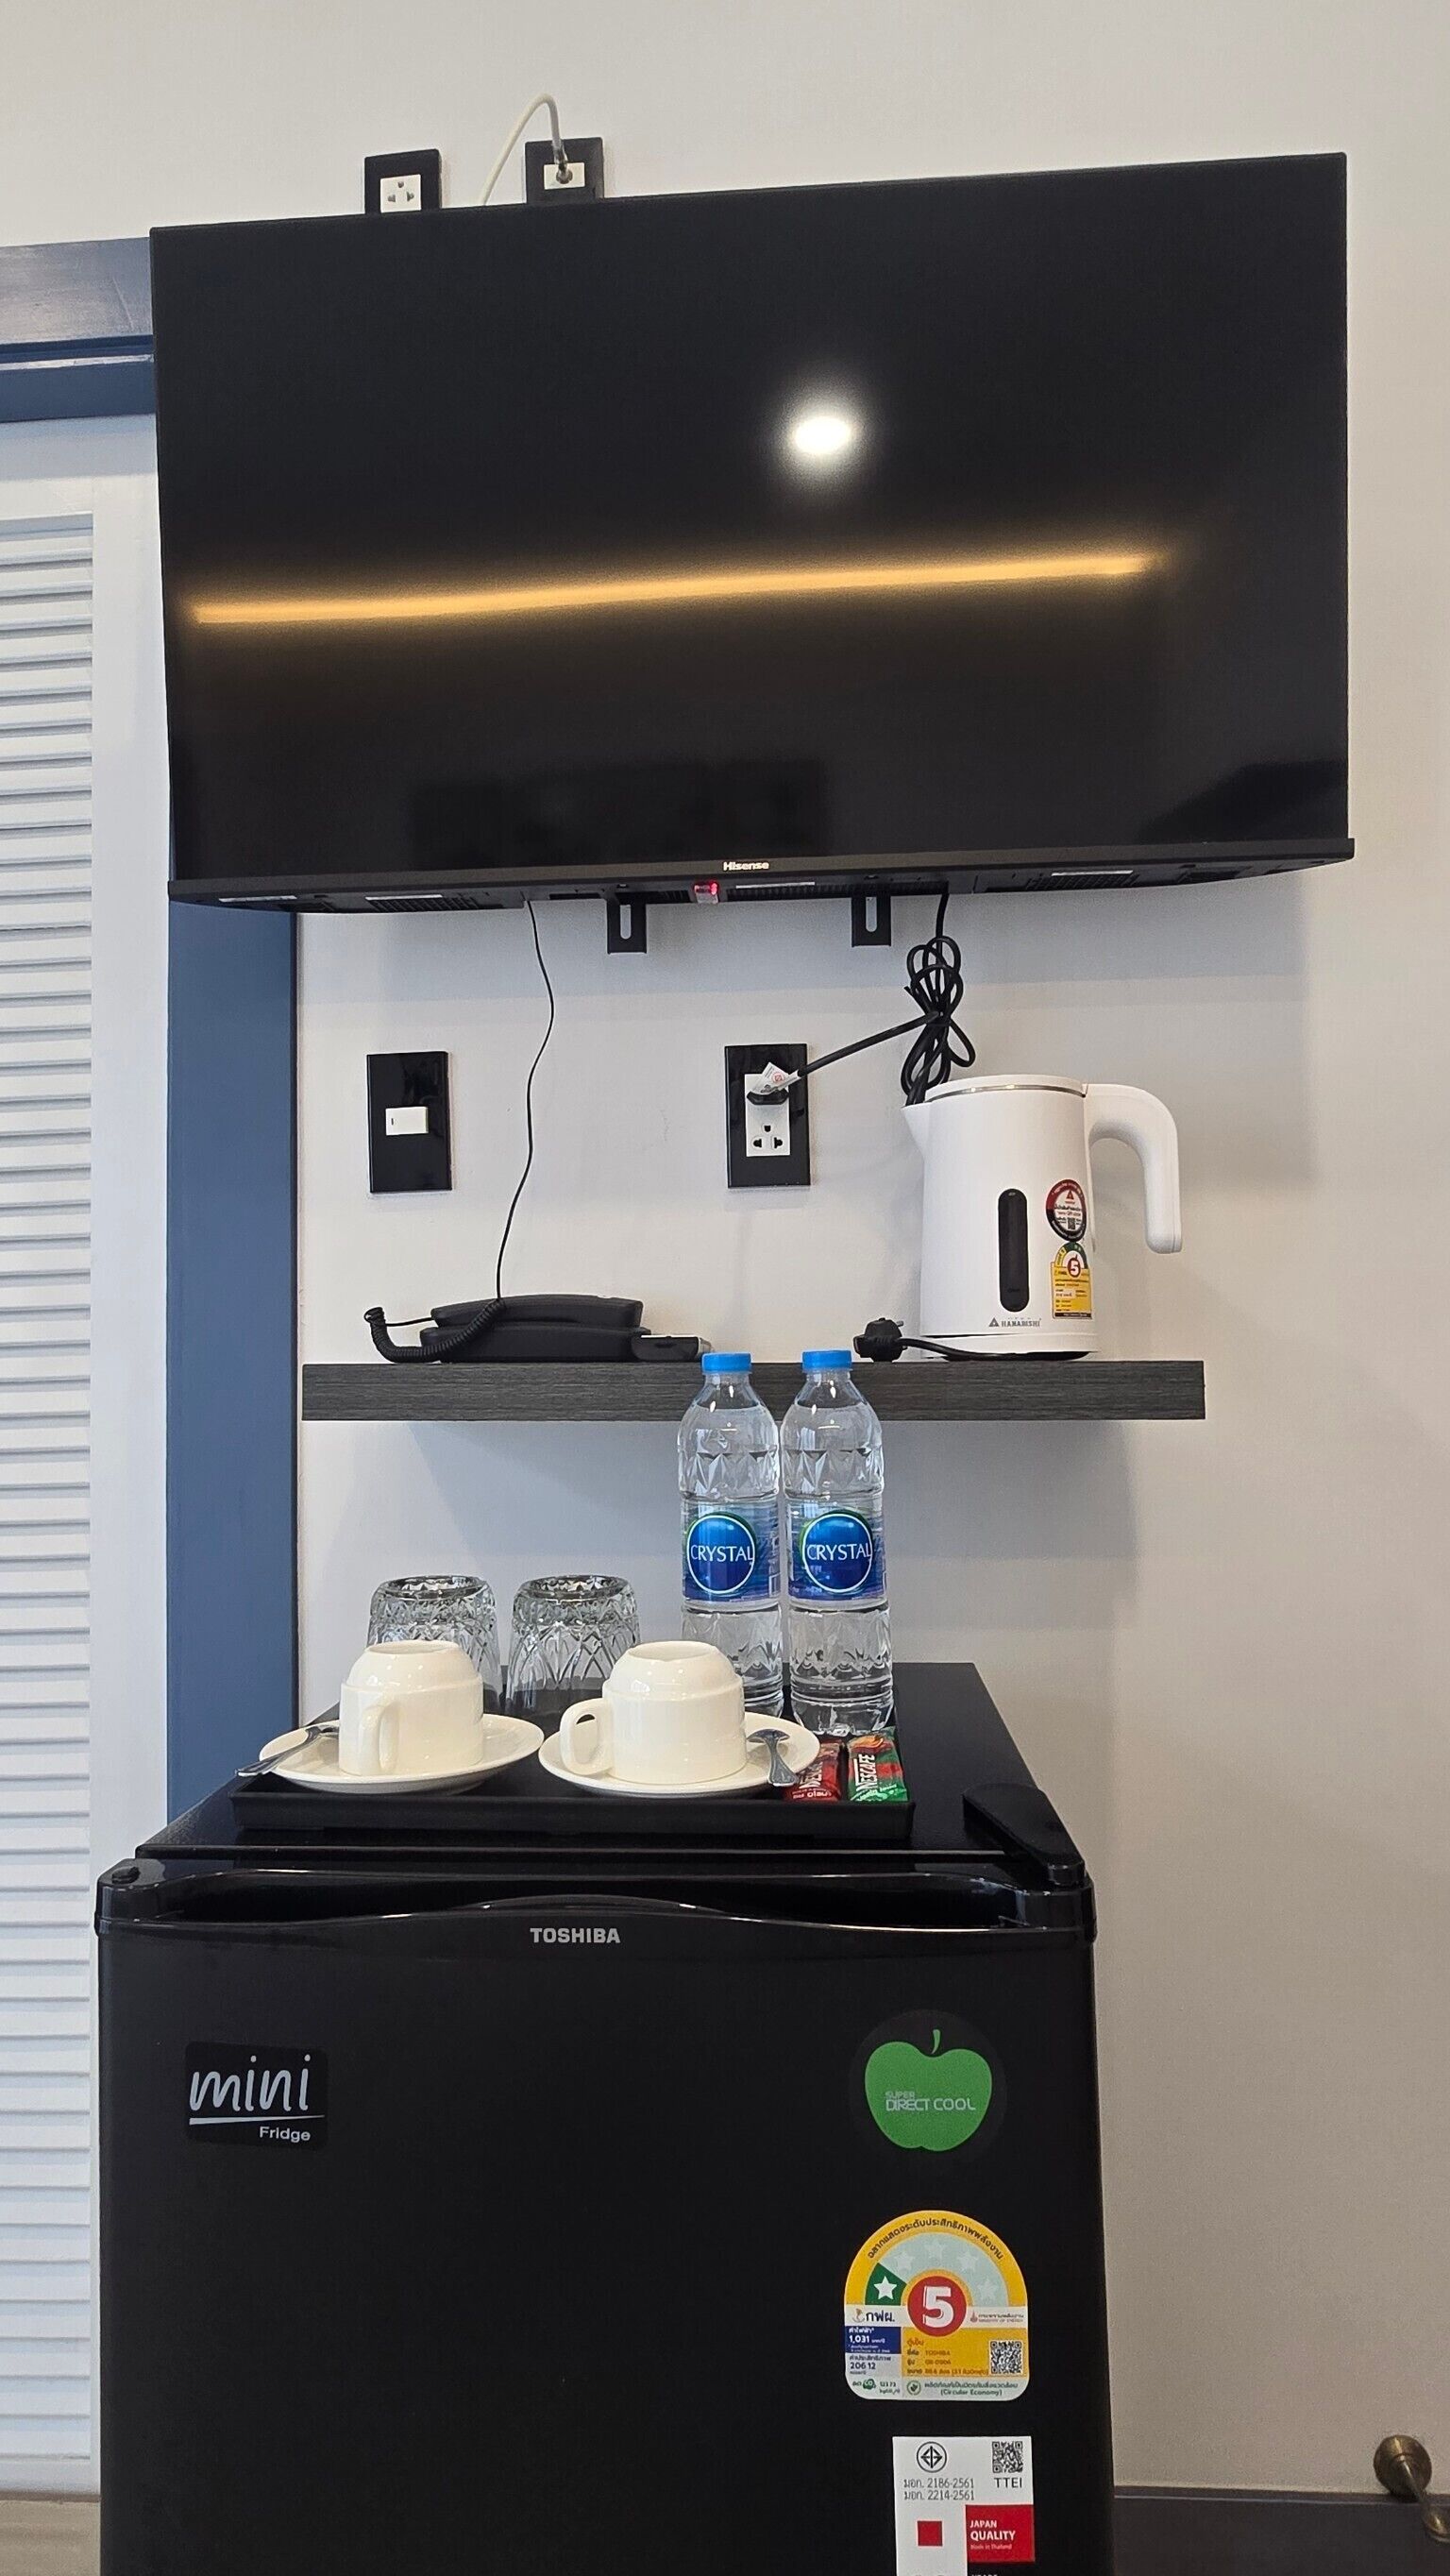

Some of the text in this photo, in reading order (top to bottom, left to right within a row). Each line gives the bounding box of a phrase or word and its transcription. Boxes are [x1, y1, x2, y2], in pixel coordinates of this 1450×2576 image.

[723, 861, 769, 871] Hisense
[1070, 1259, 1080, 1276] 5
[690, 1544, 754, 1563] CRYSTAL
[806, 1542, 872, 1562] CRYSTAL
[530, 1927, 621, 1943] TOSHIBA
[189, 2054, 312, 2111] mini
[885, 2091, 916, 2099] SUPER
[885, 2097, 976, 2111] DIRECT COOL
[260, 2127, 312, 2144] Fridge
[921, 2284, 954, 2329] 5
[866, 2310, 895, 2322] กฟผ.
[849, 2335, 870, 2345] 1,031
[940, 2387, 1003, 2397] (Circular Economy)
[903, 2478, 974, 2488] มอก. 2186-2561
[994, 2477, 1022, 2488] TTEI
[903, 2490, 975, 2500] มอก. 2214-2561
[969, 2519, 997, 2529] JAPAN
[969, 2531, 1016, 2541] QUALITY
